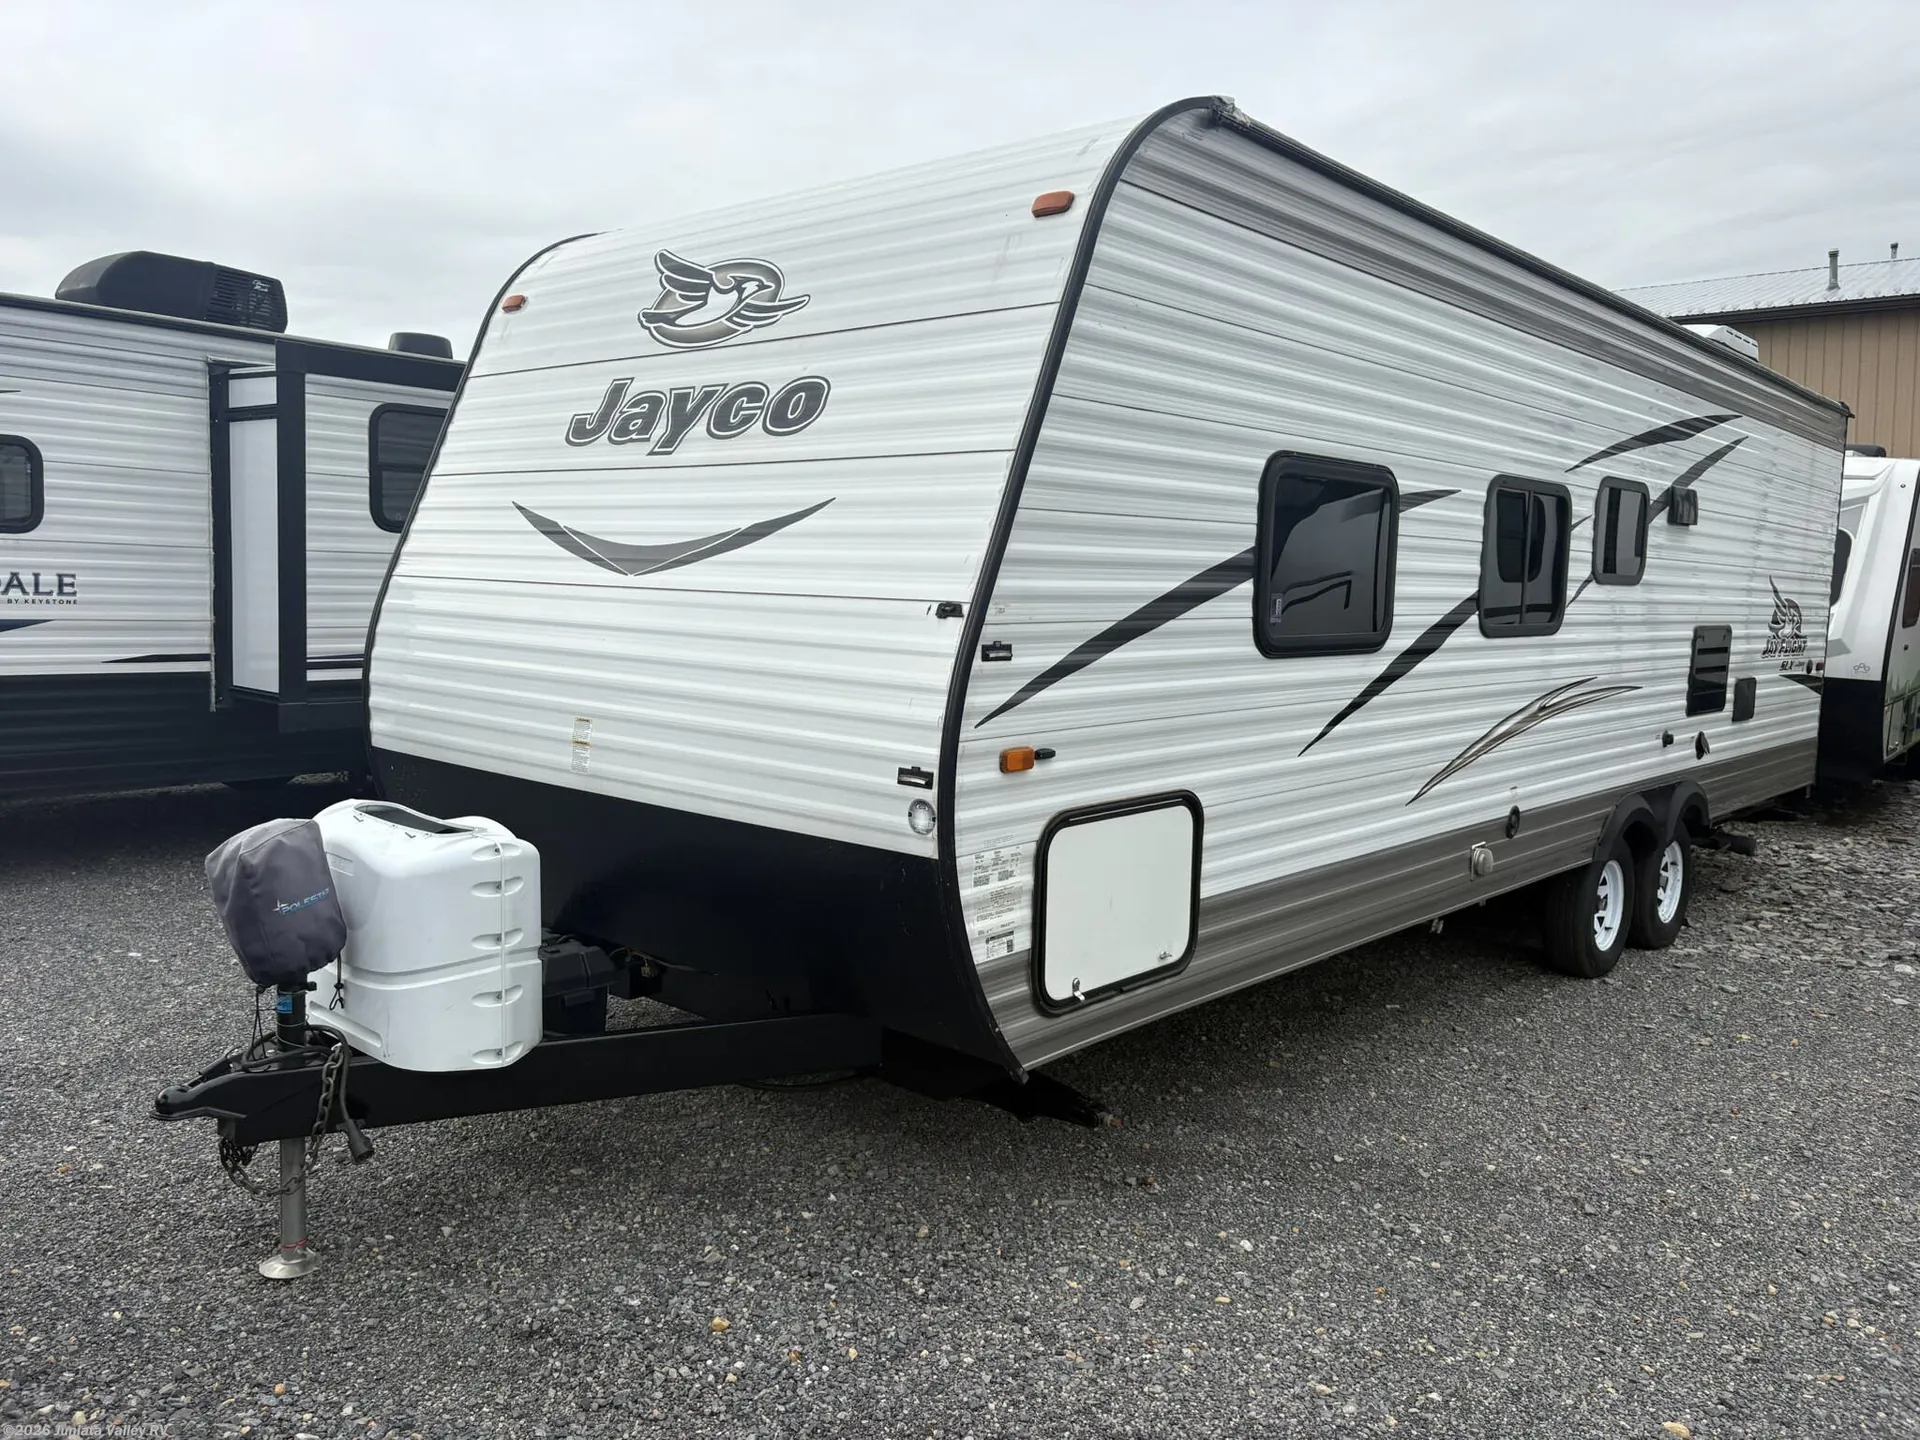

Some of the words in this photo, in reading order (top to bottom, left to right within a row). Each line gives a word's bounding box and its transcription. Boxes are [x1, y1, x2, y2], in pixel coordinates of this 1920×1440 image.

[565, 375, 831, 456] Jayco
[0, 572, 77, 597] ALE
[1762, 639, 1779, 657] JAY
[1778, 639, 1808, 656] FLIGHT
